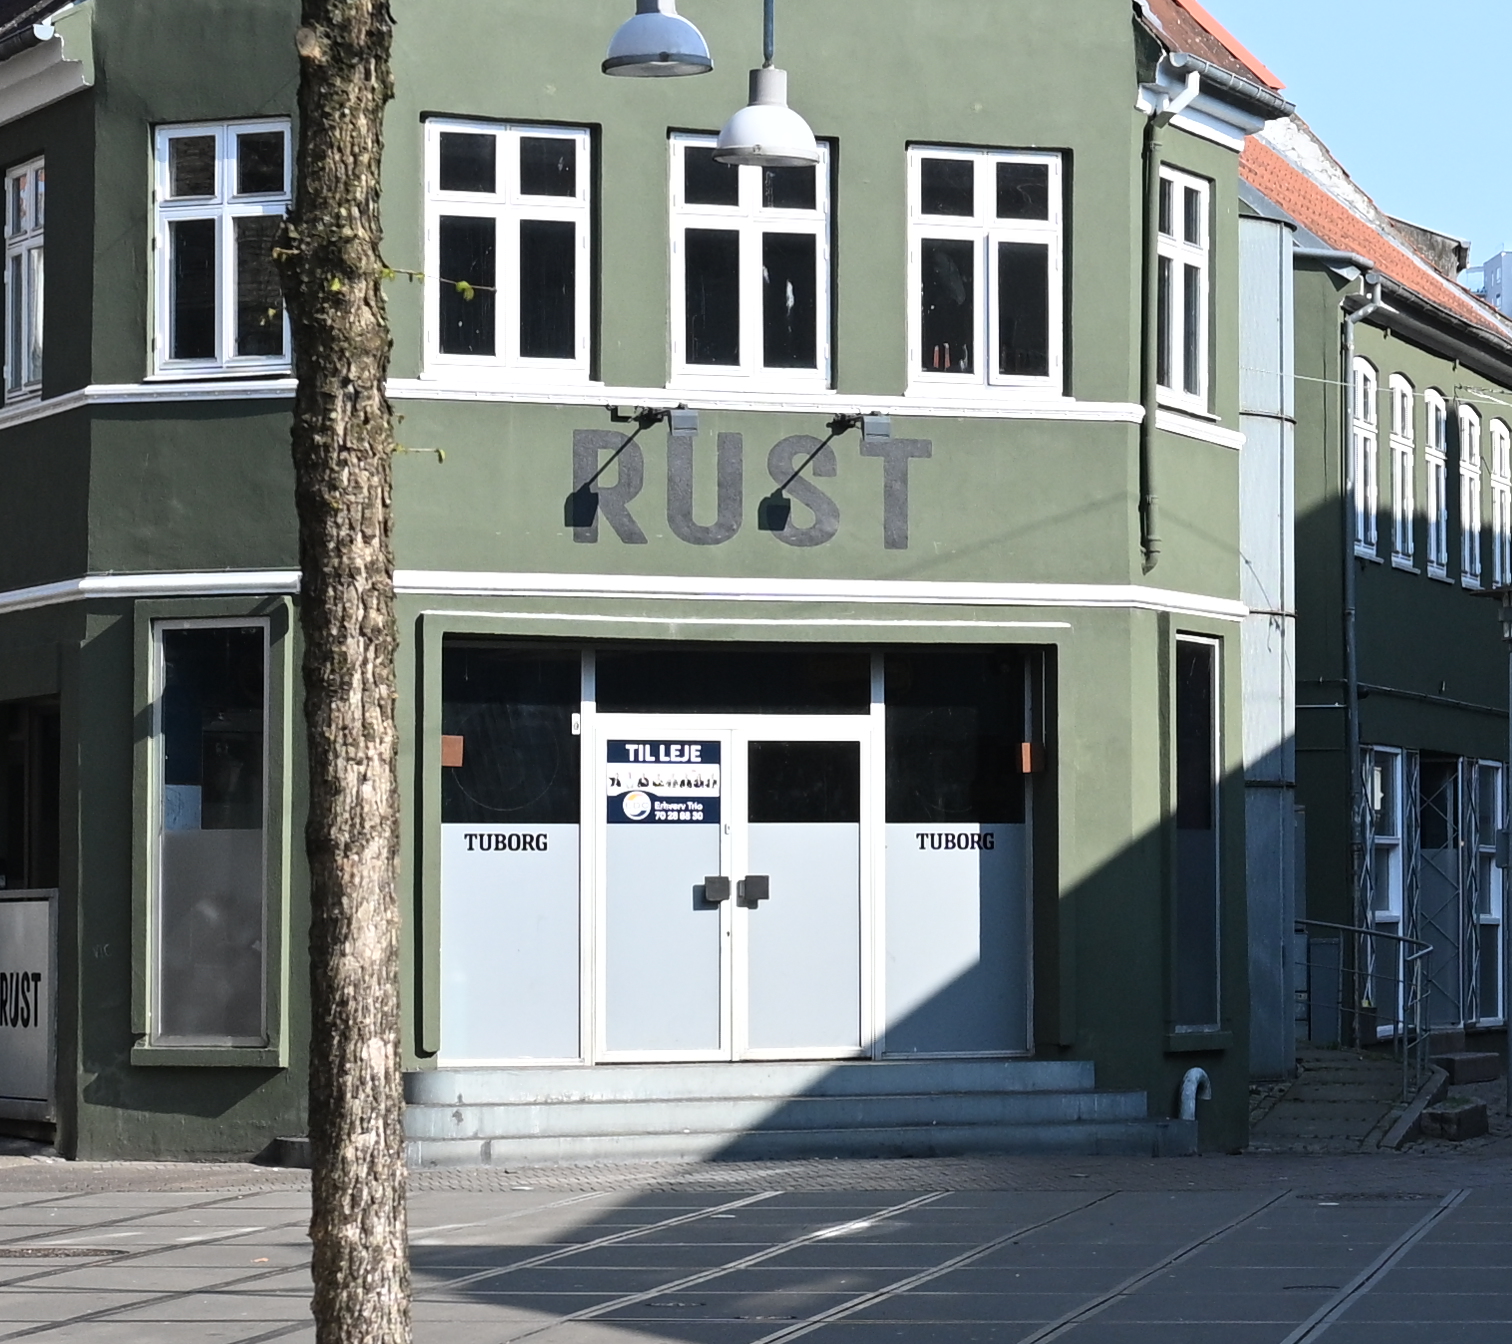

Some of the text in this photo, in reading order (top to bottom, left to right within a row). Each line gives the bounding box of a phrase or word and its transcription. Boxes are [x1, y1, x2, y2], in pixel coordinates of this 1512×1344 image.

[572, 428, 933, 550] RUST
[625, 743, 702, 762] TIL LEJE
[464, 833, 548, 851] TUBORG
[915, 832, 995, 850] TUBORG
[0, 971, 42, 1029] RUST
